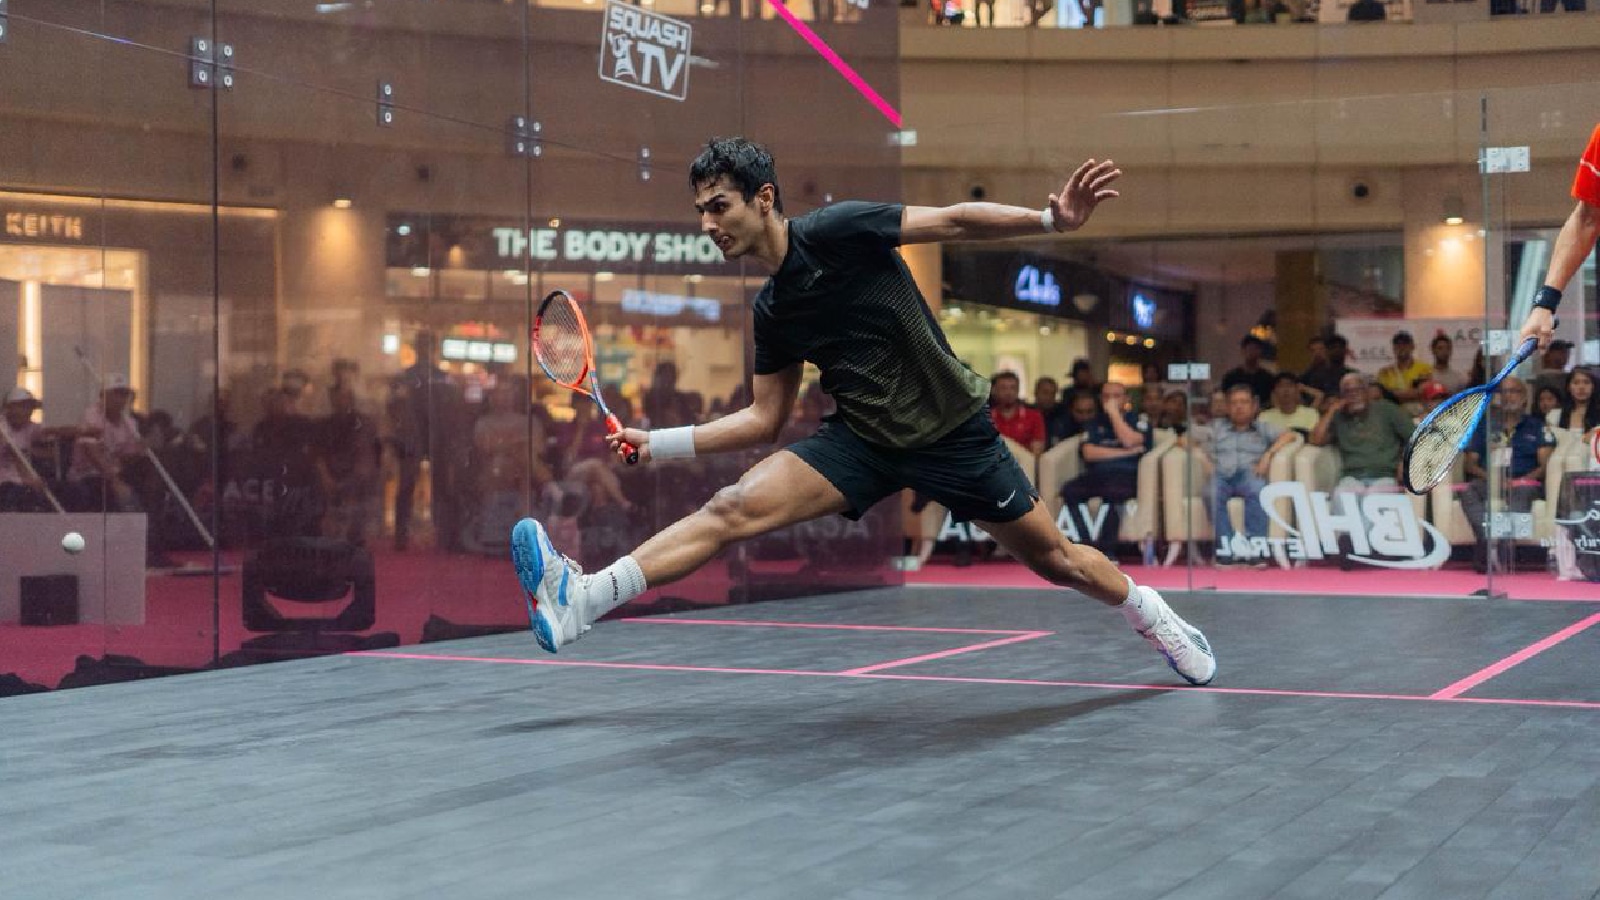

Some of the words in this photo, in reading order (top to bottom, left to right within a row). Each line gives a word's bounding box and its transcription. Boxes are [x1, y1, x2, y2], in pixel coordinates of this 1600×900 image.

[609, 5, 687, 50] SQUASH
[637, 40, 685, 90] TV
[6, 212, 82, 238] KEITH
[494, 227, 557, 260] THE
[564, 230, 650, 262] BODY
[655, 232, 725, 263] SHO
